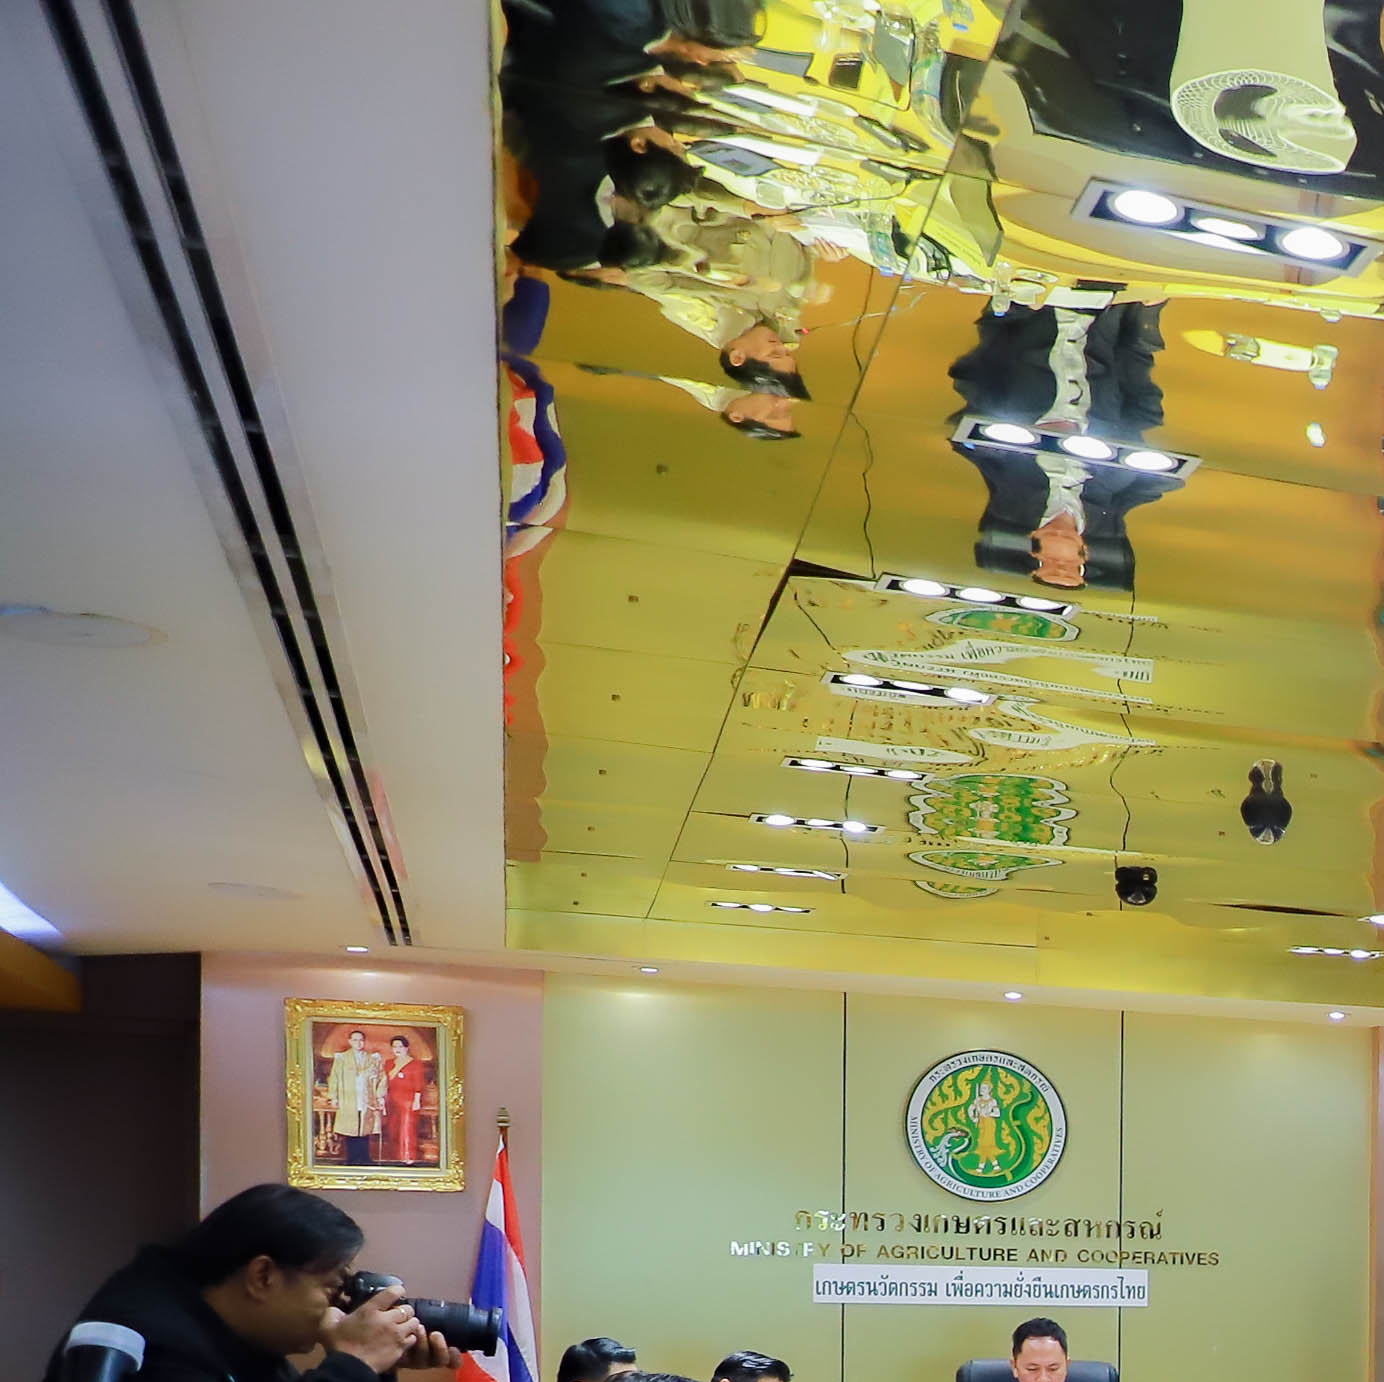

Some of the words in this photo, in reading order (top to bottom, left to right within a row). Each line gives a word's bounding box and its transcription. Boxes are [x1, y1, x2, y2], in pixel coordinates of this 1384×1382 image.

[934, 1172, 1000, 1198] AGRICULTURE
[1024, 1127, 1063, 1190] COOPERATIVES
[730, 1240, 831, 1258] MINISRY
[841, 1243, 867, 1258] OF
[876, 1244, 1018, 1263] AGRICULTURE
[1026, 1248, 1067, 1263] AND
[1077, 1249, 1220, 1266] COOPERATIVES
